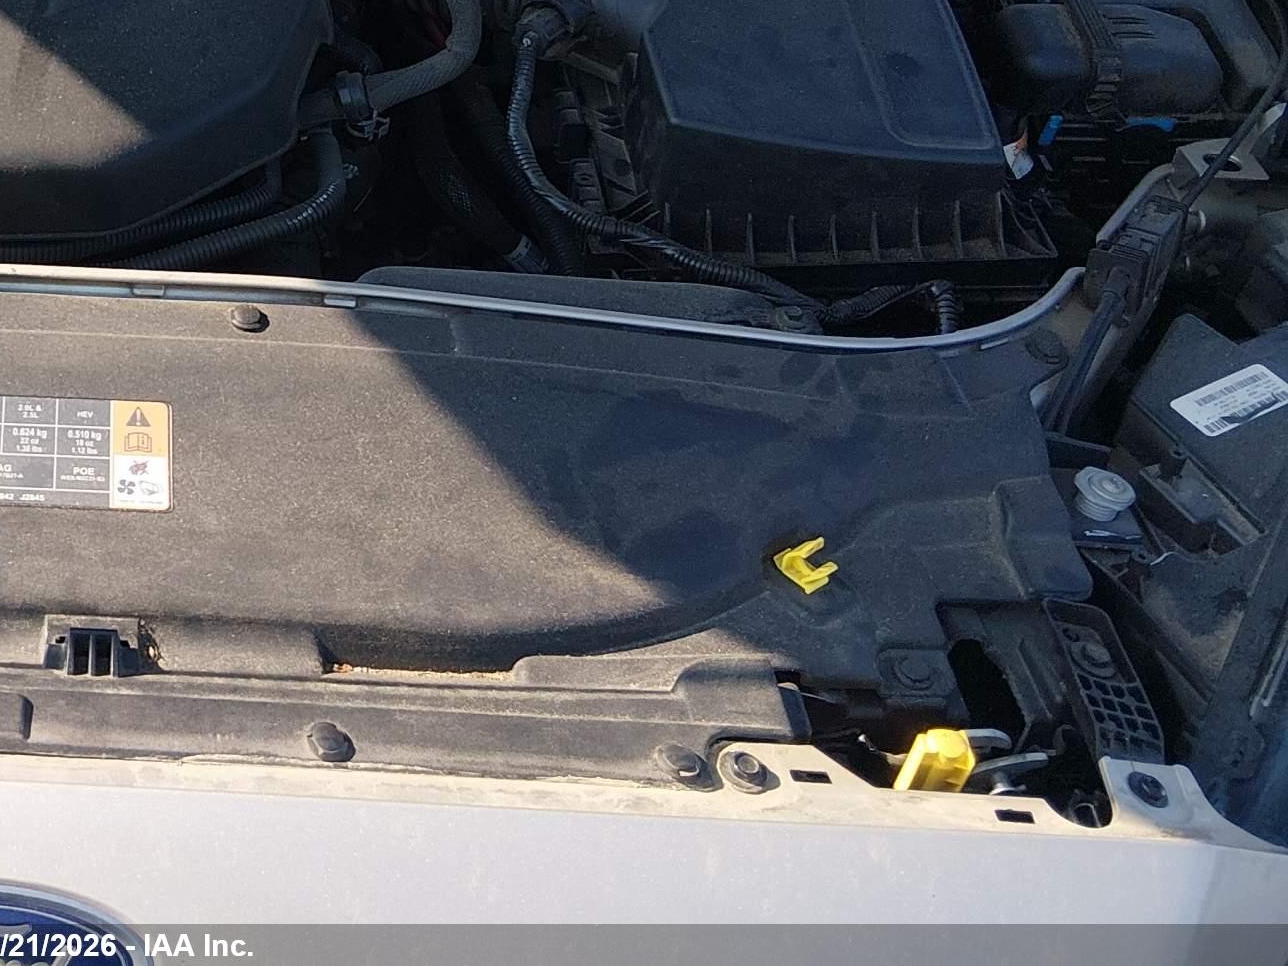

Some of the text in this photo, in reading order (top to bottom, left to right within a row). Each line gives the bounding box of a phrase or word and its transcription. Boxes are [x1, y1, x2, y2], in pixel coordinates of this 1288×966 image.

[36, 428, 47, 439] kg
[91, 430, 102, 441] kg
[73, 466, 95, 475] POE
